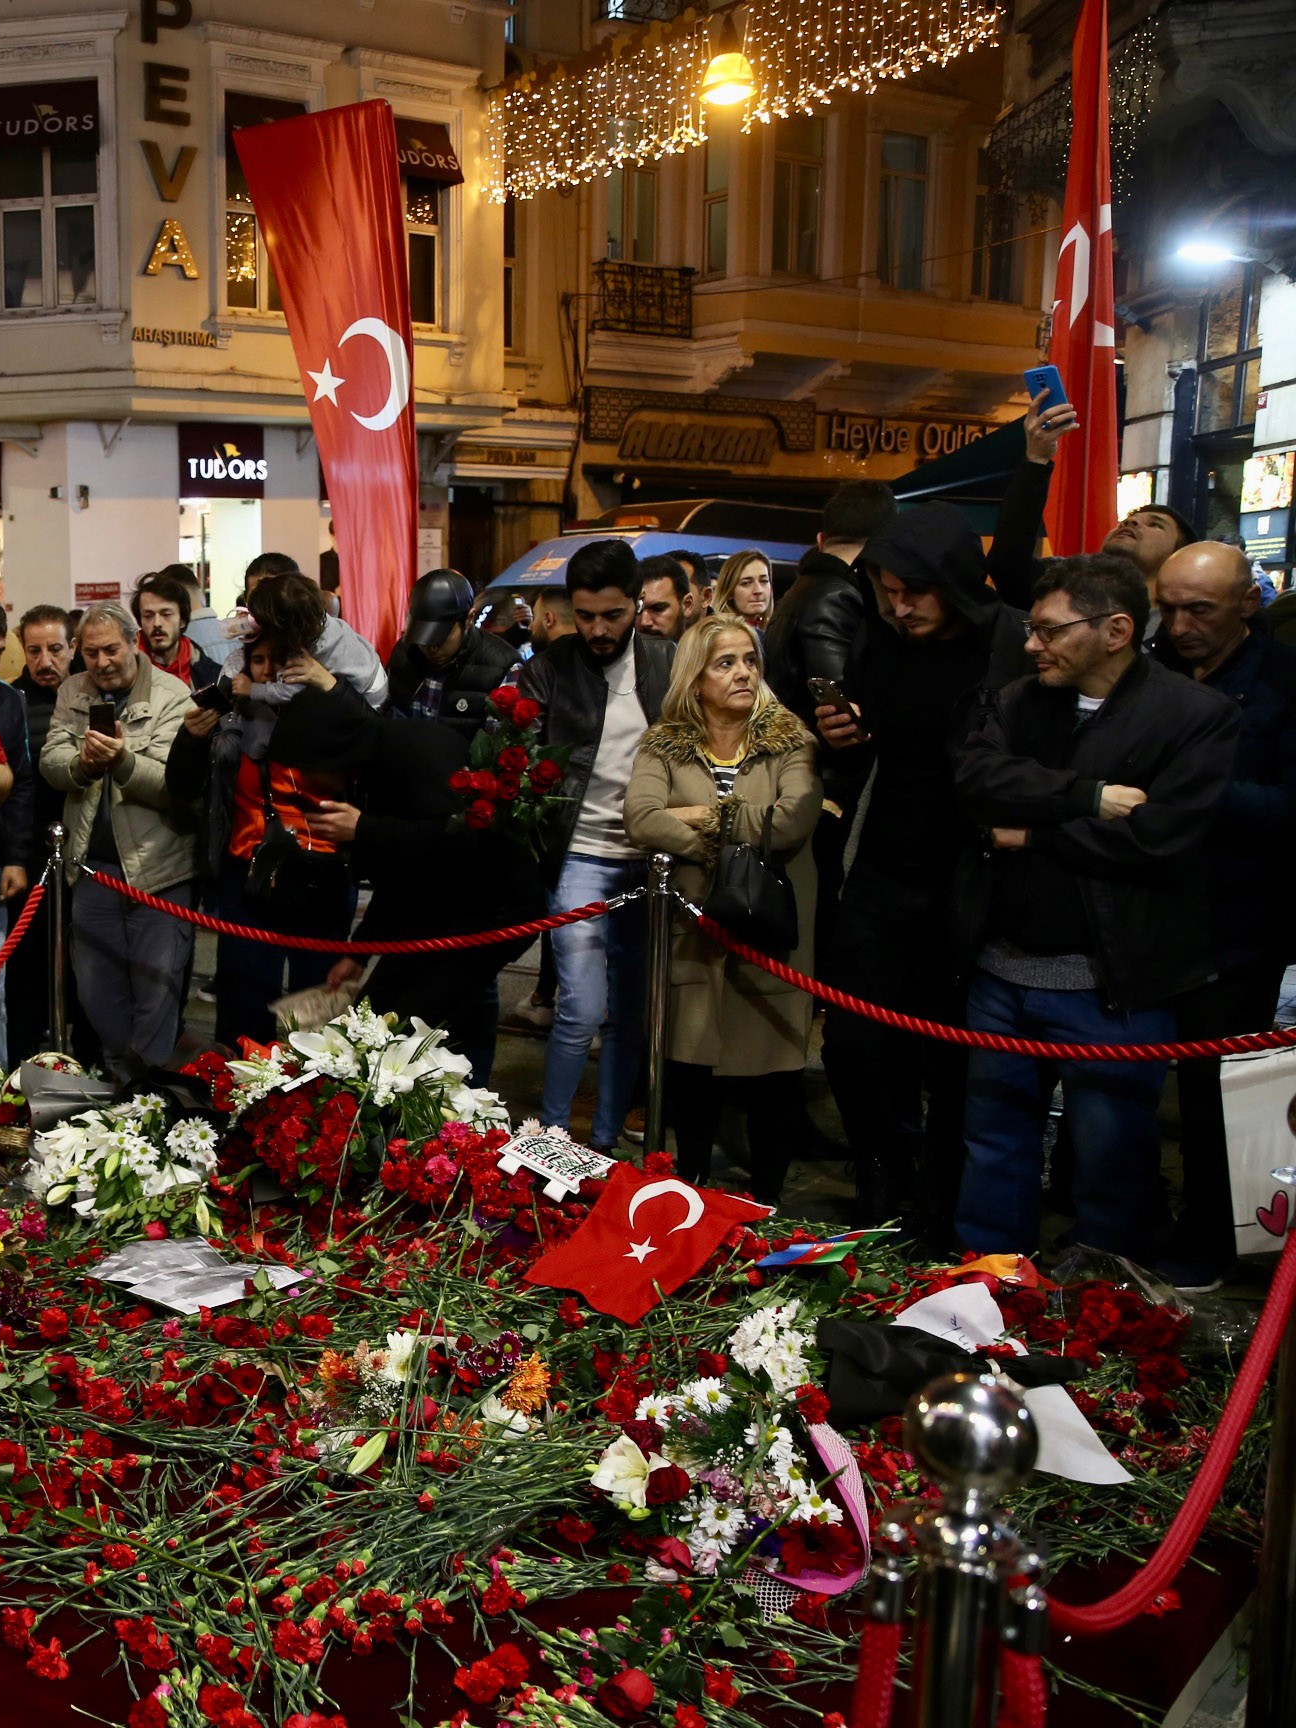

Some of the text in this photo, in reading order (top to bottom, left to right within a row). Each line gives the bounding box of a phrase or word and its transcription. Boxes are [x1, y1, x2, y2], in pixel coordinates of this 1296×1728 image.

[140, 0, 200, 280] PEVA
[398, 149, 460, 171] UDORS
[132, 326, 218, 348] ARAŞTIRMA
[619, 420, 778, 464] ALBAYRAK
[829, 414, 911, 458] Heybe
[188, 458, 269, 481] TUDORS
[511, 1145, 576, 1181] PALESTINE
